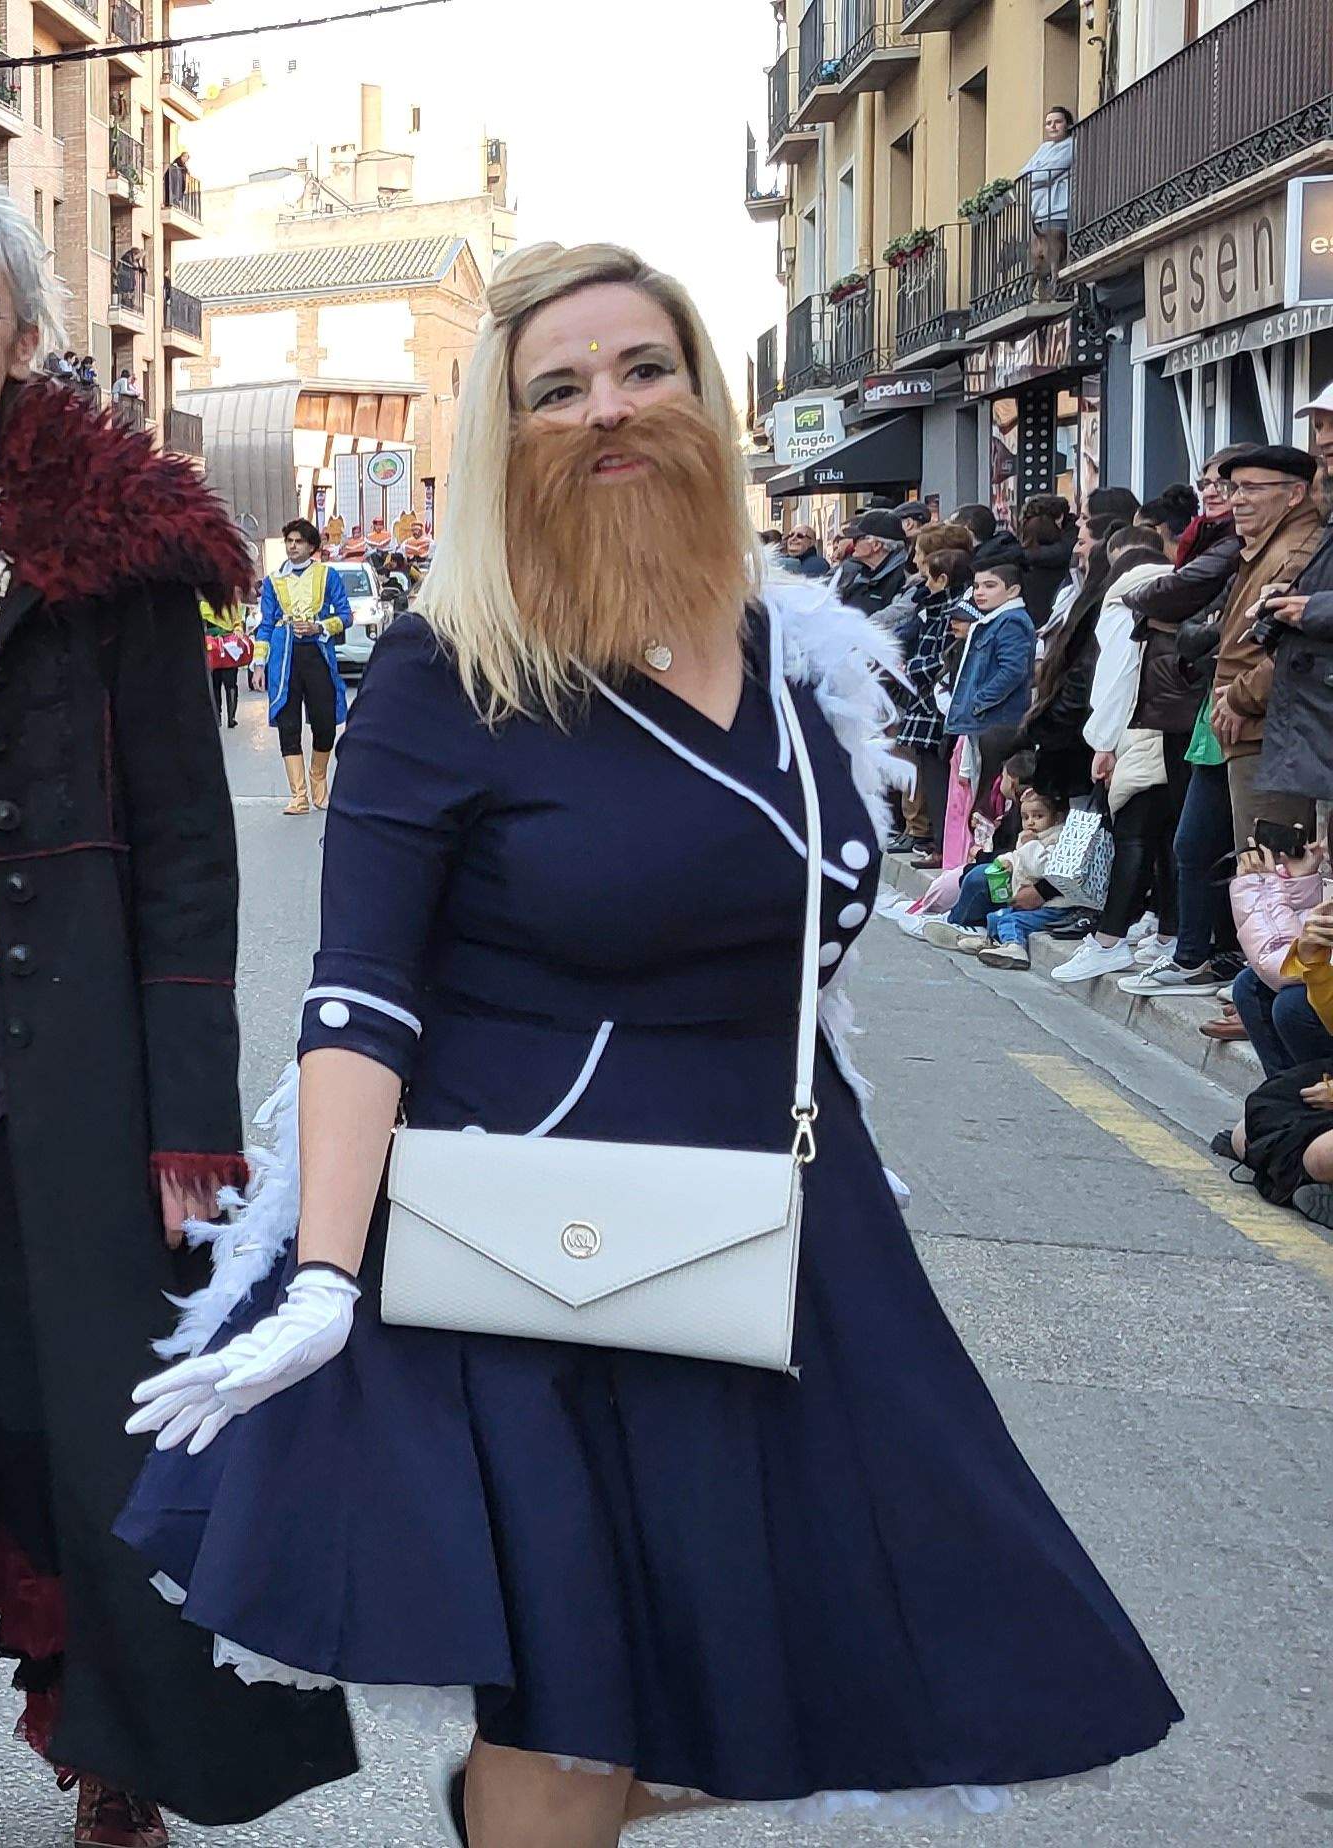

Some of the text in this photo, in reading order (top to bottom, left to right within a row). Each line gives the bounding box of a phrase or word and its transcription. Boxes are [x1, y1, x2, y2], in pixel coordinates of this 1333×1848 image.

[1310, 236, 1333, 256] e
[1158, 216, 1275, 324] esen
[786, 433, 835, 448] Aragón
[790, 447, 833, 459] Finca
